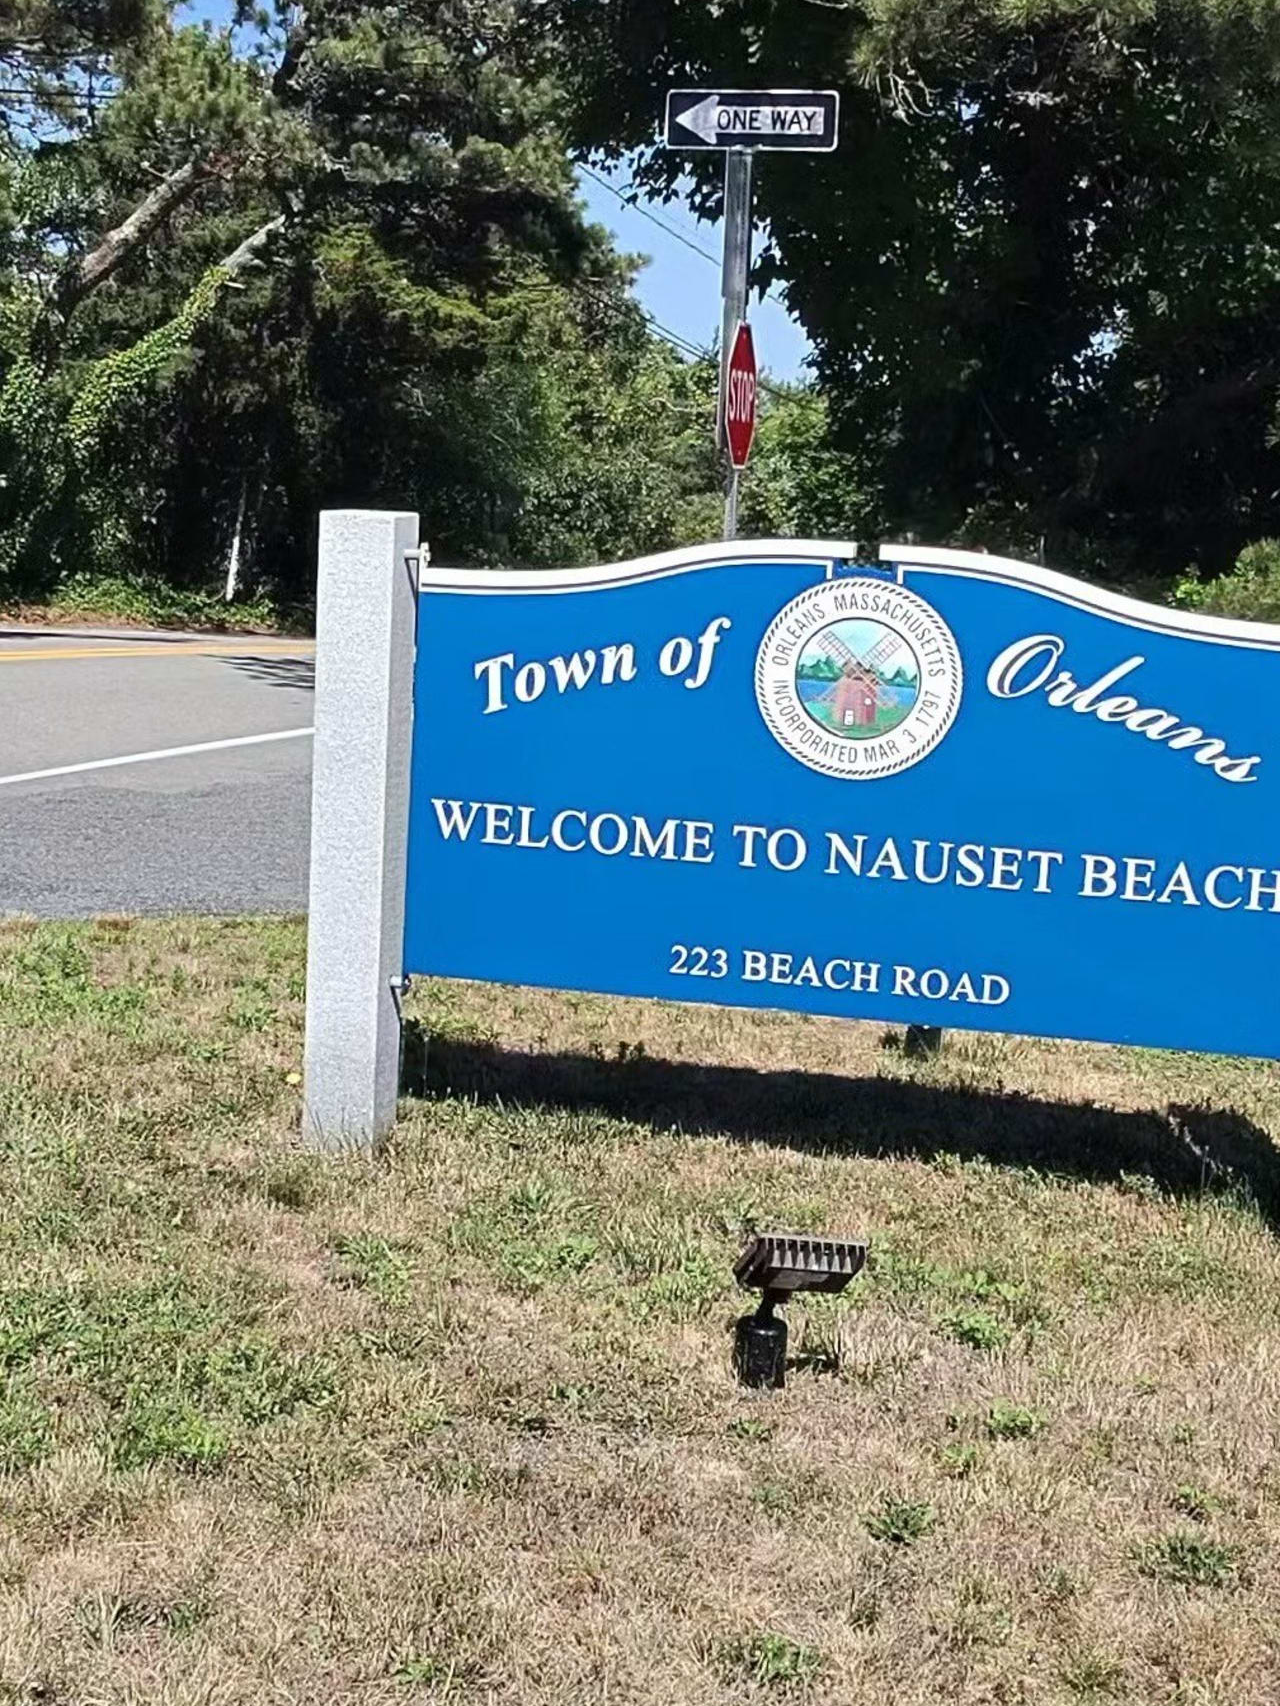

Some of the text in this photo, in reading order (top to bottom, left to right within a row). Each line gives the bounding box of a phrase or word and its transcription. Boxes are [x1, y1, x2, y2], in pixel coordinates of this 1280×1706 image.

[717, 109, 817, 132] ONE WAY
[729, 368, 754, 423] STOP
[772, 593, 946, 678] ORLEANS MASSACHUSETTS
[474, 617, 1262, 783] Town of Orleans
[773, 680, 858, 764] INCORPORATED
[863, 738, 900, 764] MAR
[915, 689, 942, 727] 1797
[431, 798, 715, 863] WELCOME
[732, 825, 808, 871] TO
[824, 832, 1063, 894] NAUSET
[668, 945, 1011, 1006] 223 BEACH ROAD
